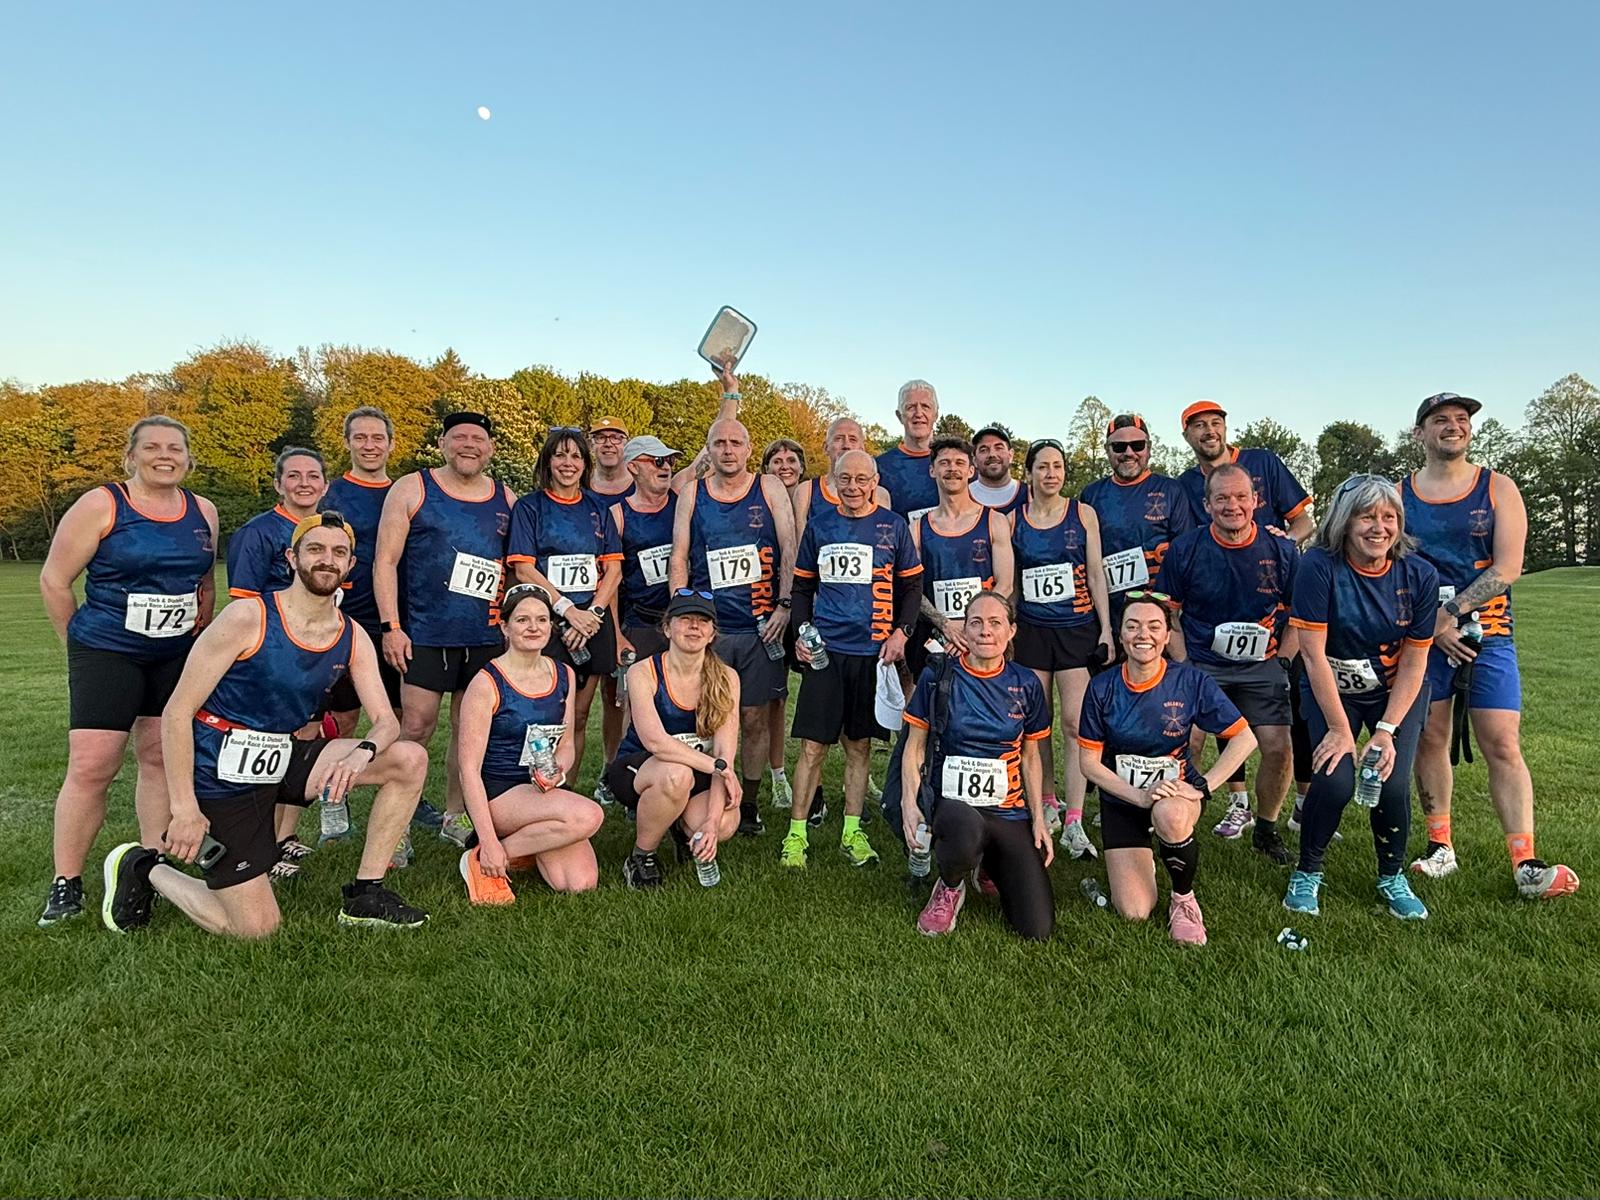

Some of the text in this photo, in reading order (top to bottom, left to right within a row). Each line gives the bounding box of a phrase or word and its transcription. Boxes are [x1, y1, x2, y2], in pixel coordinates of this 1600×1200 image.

[561, 566, 589, 586] 178
[653, 556, 670, 577] 17
[720, 558, 750, 580] 179
[830, 556, 861, 576] 193
[1108, 561, 1135, 586] 177
[465, 568, 496, 594] 192
[1034, 576, 1064, 598] 165
[872, 563, 893, 640] YORK
[945, 590, 972, 611] 183
[145, 609, 186, 631] 172
[1226, 635, 1257, 655] 191
[1338, 671, 1367, 689] 58
[237, 748, 281, 776] 160
[958, 772, 995, 798] 184
